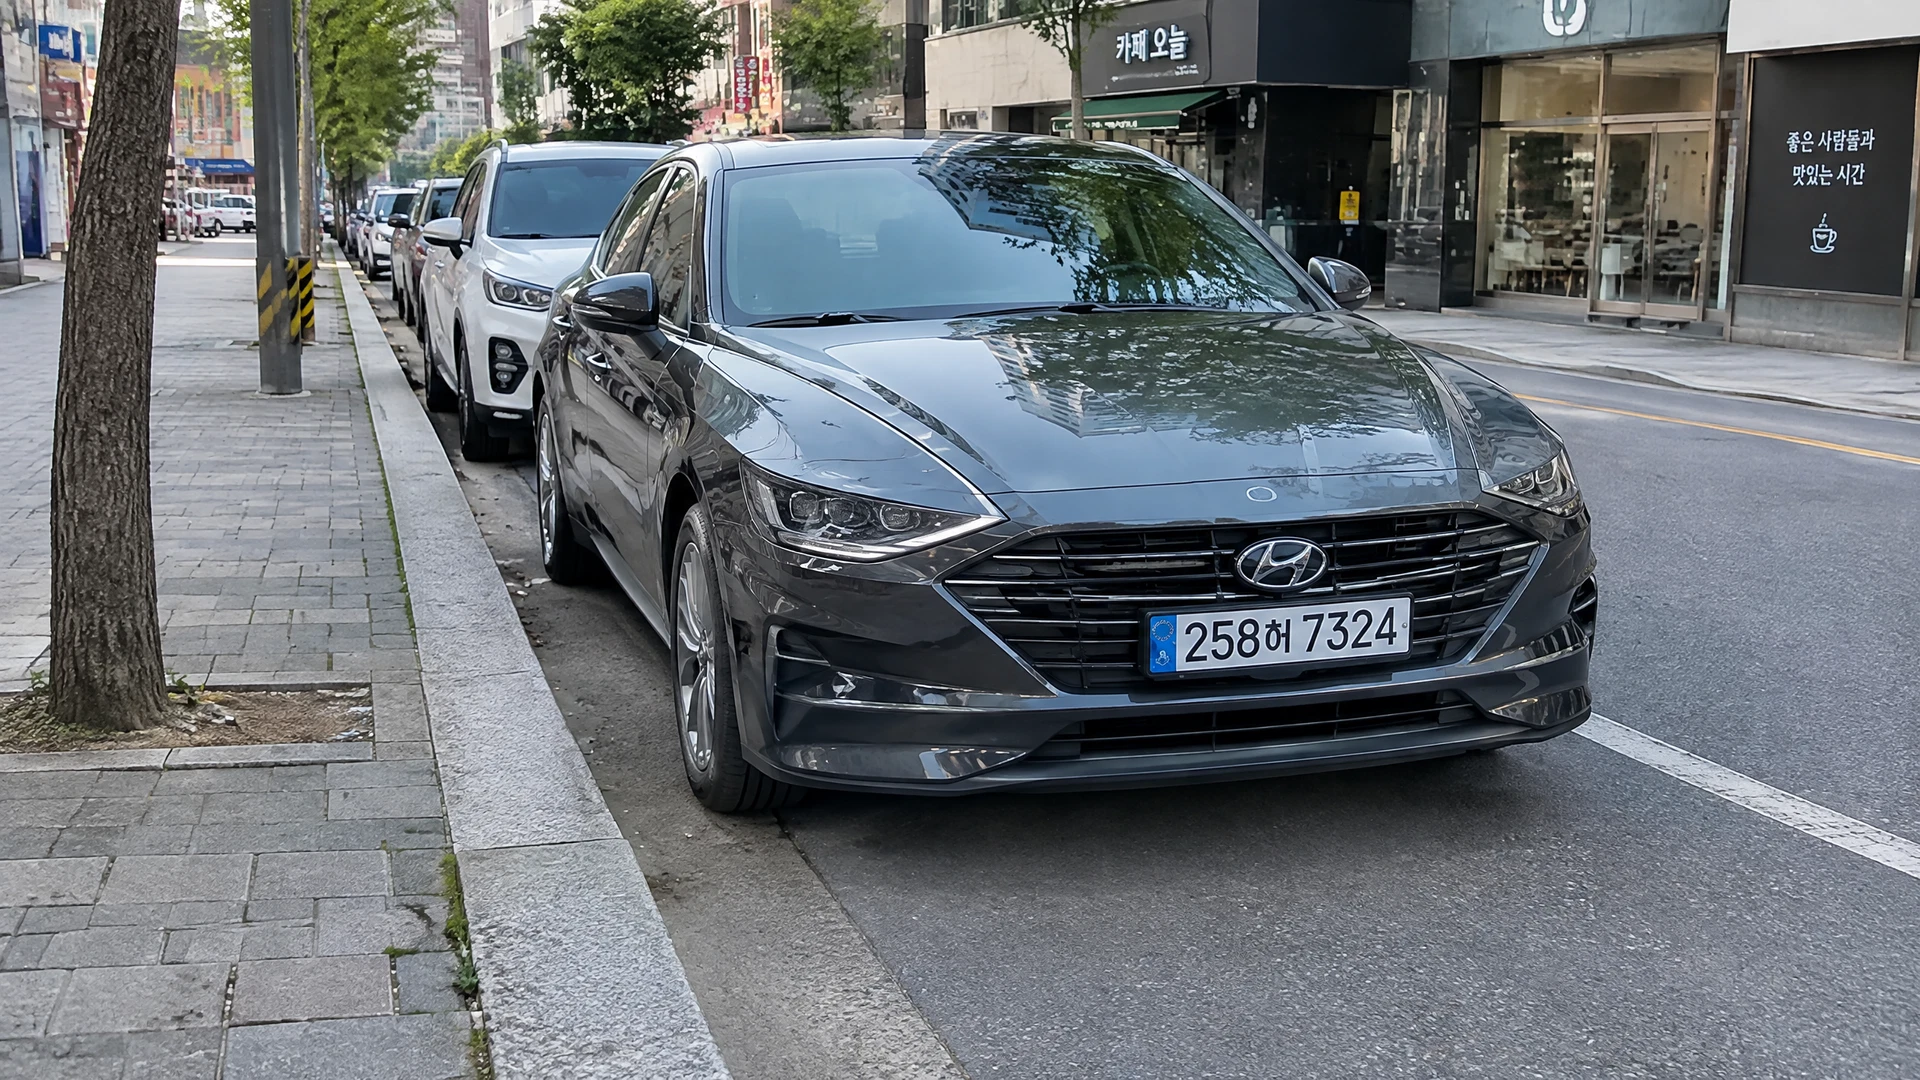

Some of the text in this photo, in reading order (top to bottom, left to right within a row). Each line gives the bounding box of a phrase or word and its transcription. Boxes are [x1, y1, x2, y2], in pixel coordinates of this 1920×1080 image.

[1150, 24, 1188, 60] 오늘
[1786, 131, 1814, 153] 좋은
[1792, 162, 1865, 186] 맛있는 시간
[1184, 618, 1291, 663] 258허
[1302, 606, 1397, 653] 7324
